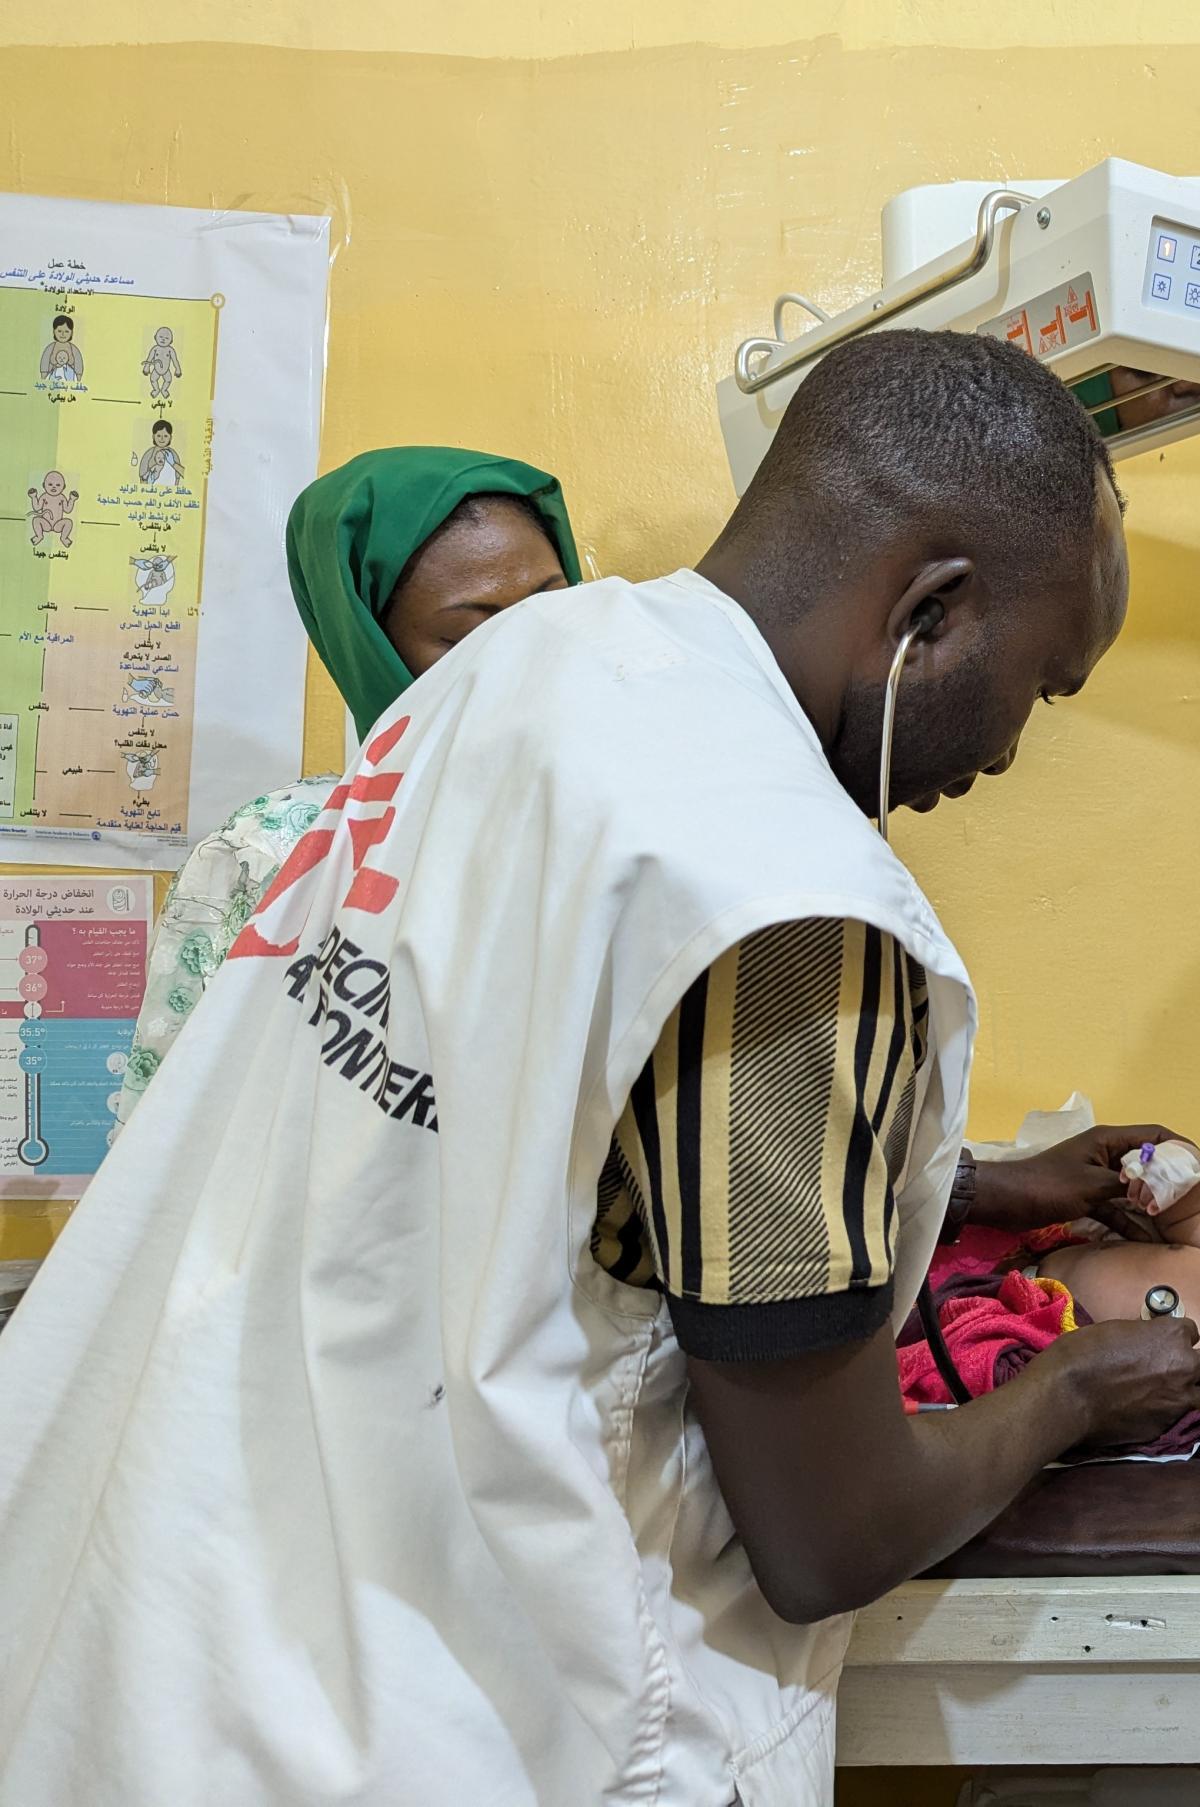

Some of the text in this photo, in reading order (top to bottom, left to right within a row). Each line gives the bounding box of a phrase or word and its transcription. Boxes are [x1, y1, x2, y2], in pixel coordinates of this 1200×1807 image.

[48, 258, 86, 270] خطة عمل
[28, 269, 45, 281] على
[49, 270, 75, 283] الولادة
[76, 272, 101, 285] حديثي
[104, 274, 134, 285] مساعدة
[55, 304, 76, 314] الولادة
[68, 394, 76, 402] هل
[151, 400, 173, 409] لا يبكي
[140, 545, 166, 554] لا يتنفس
[48, 551, 69, 560] يتنفس
[37, 602, 58, 611] يتنفس
[134, 640, 161, 650] لا يتنفس
[28, 702, 49, 711] يتنفس
[127, 728, 148, 737] يتنفس
[20, 809, 47, 817] لا يتنفس
[3, 889, 94, 900] انخفاض درجة الحرارة
[15, 904, 94, 918] عند حديثي الولادة
[109, 928, 127, 937] يجب
[25, 955, 42, 964] 37°
[25, 983, 42, 992] 36°
[20, 1027, 45, 1037] 35.5°
[25, 1056, 42, 1065] 35°
